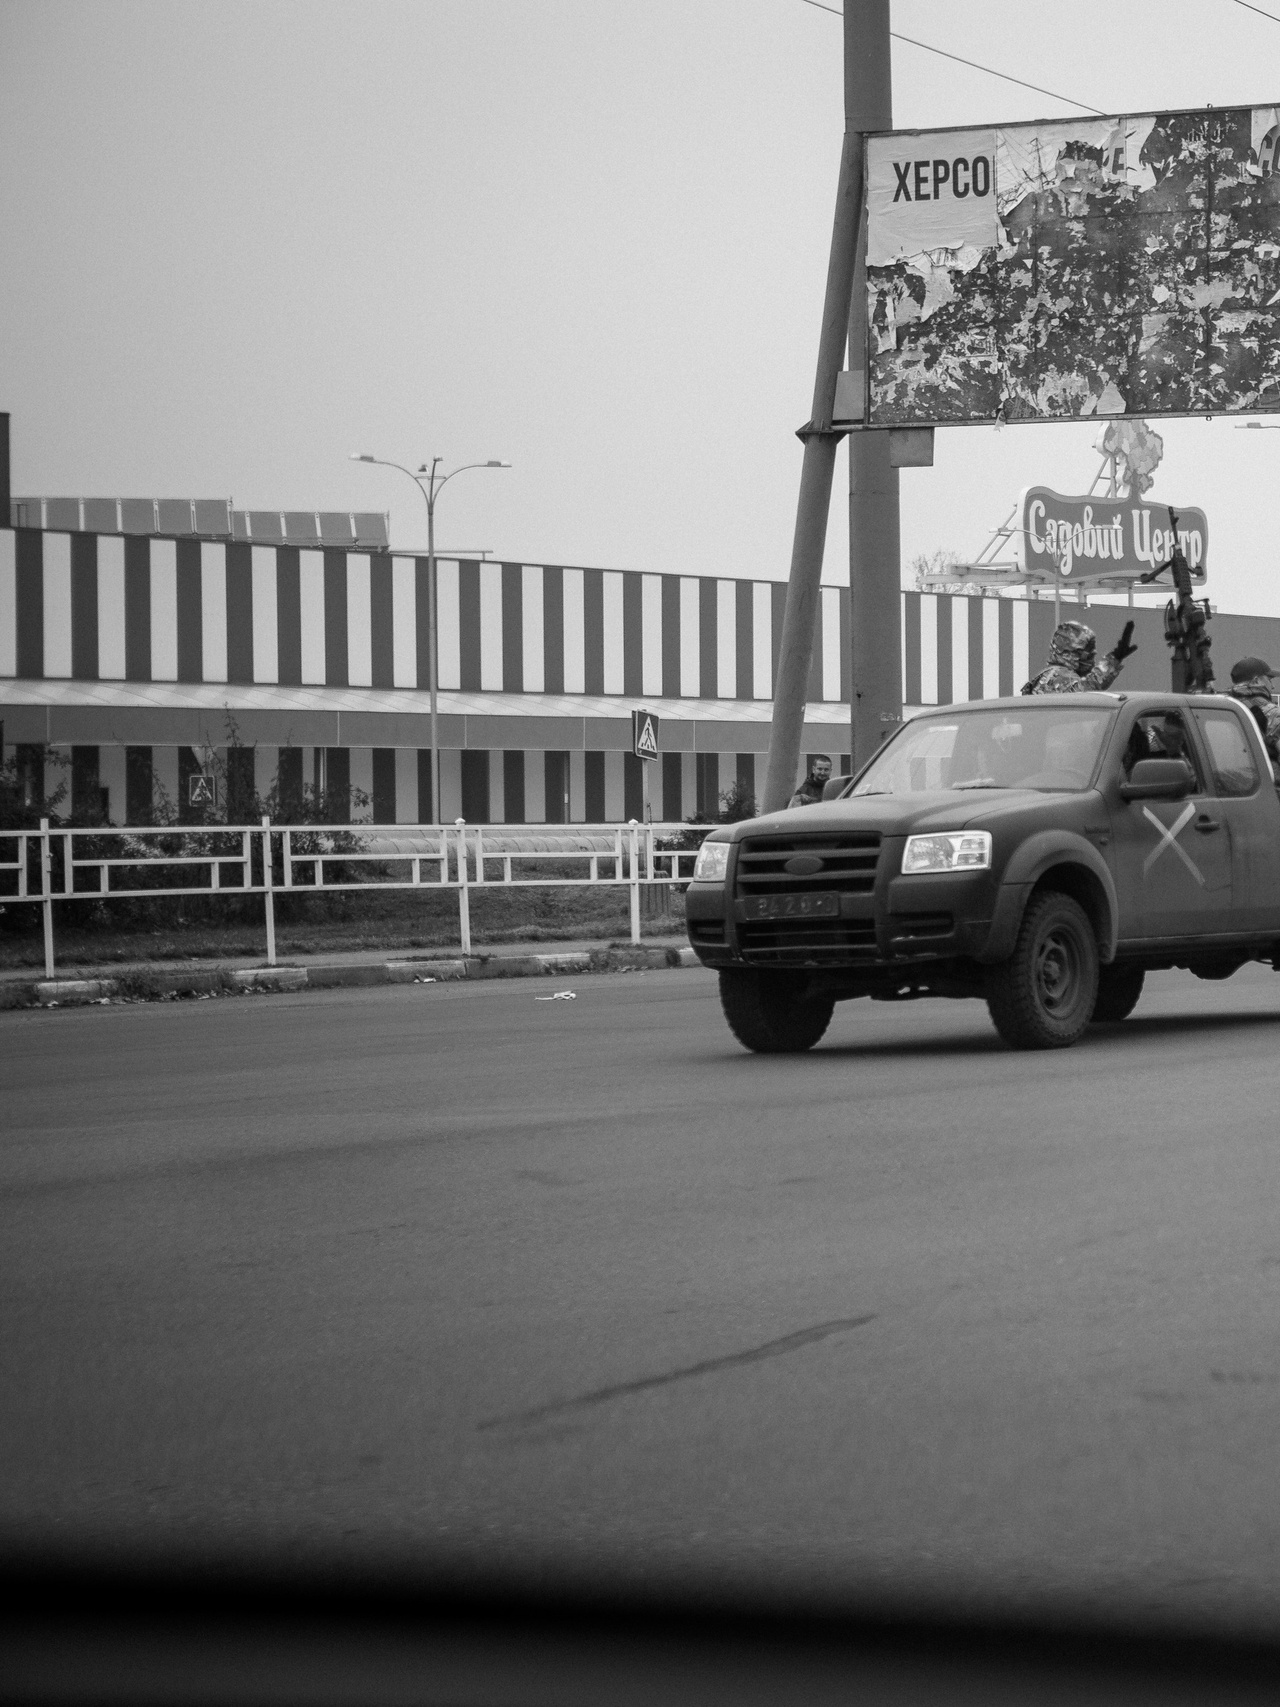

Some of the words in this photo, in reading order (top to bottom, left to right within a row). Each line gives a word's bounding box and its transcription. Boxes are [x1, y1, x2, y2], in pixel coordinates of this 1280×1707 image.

[892, 155, 995, 202] ХЕРСО
[1029, 500, 1125, 576] Садовий
[1131, 509, 1203, 569] Центр
